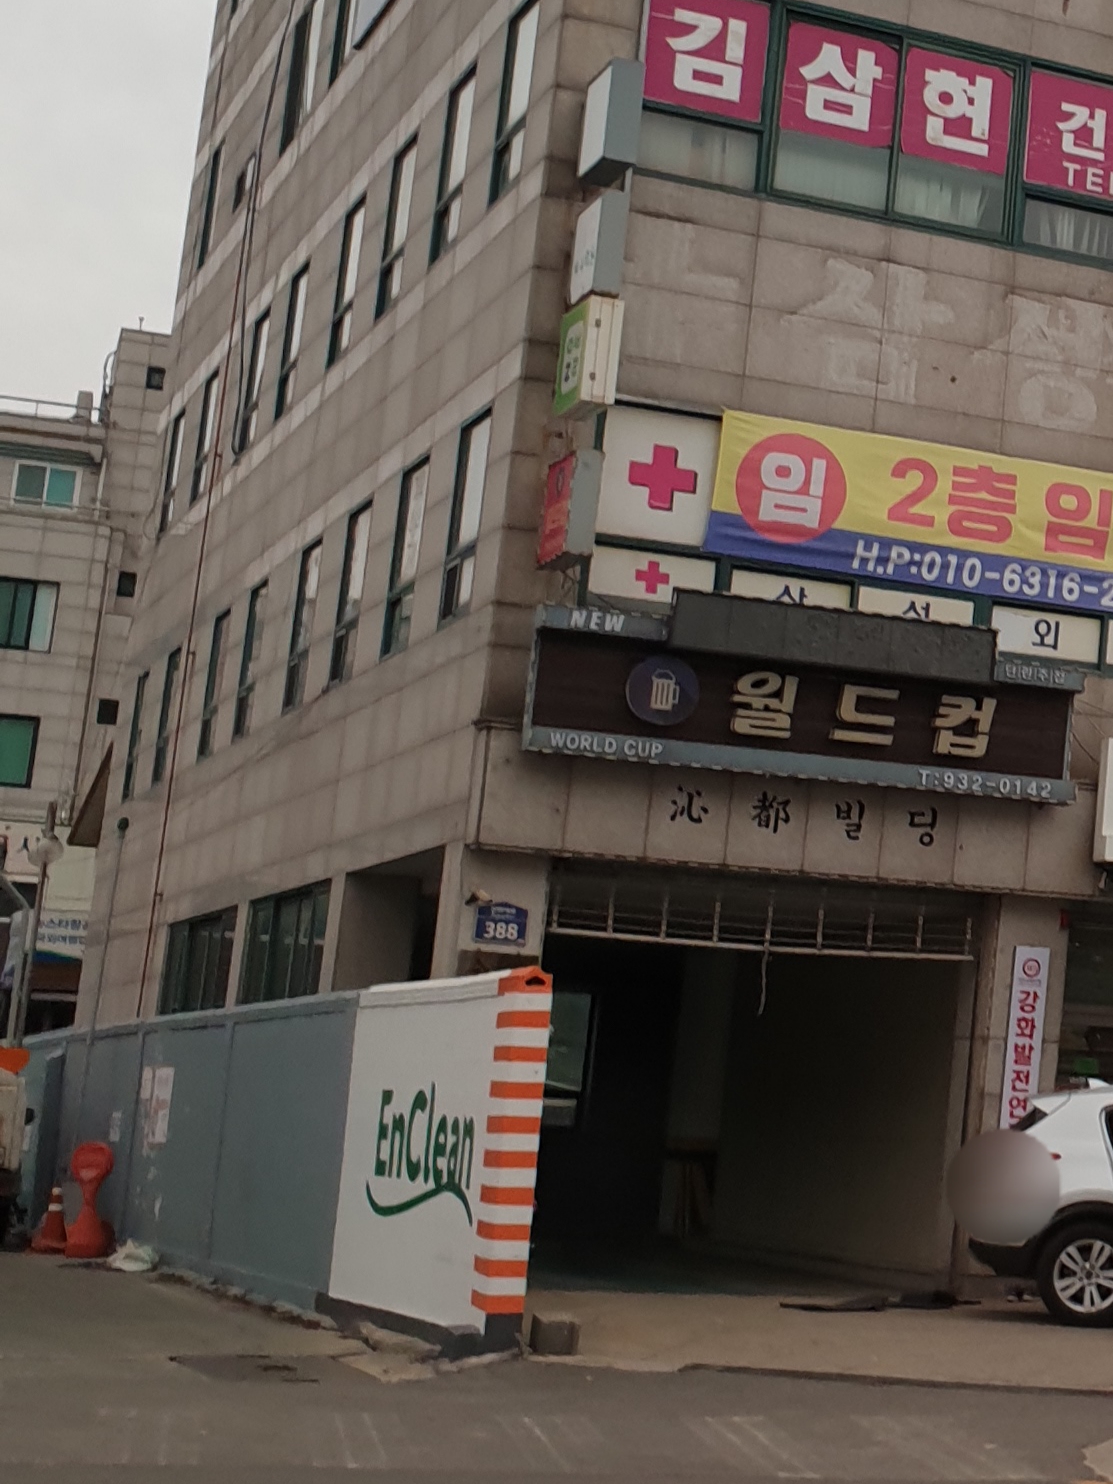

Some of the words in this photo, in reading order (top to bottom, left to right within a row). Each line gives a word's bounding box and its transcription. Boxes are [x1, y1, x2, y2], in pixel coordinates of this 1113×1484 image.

[665, 7, 993, 157] 김삼현
[758, 451, 827, 530] 임
[887, 457, 1018, 544] 2층
[571, 610, 626, 634] NEW
[550, 731, 617, 754] WORLD
[623, 739, 664, 759] CUP
[729, 669, 998, 759] 월드컵
[919, 769, 1052, 798] T:932-0142
[483, 921, 519, 941] 388
[1007, 990, 1040, 1129] 강화발전연
[373, 1080, 475, 1191] EnClean
